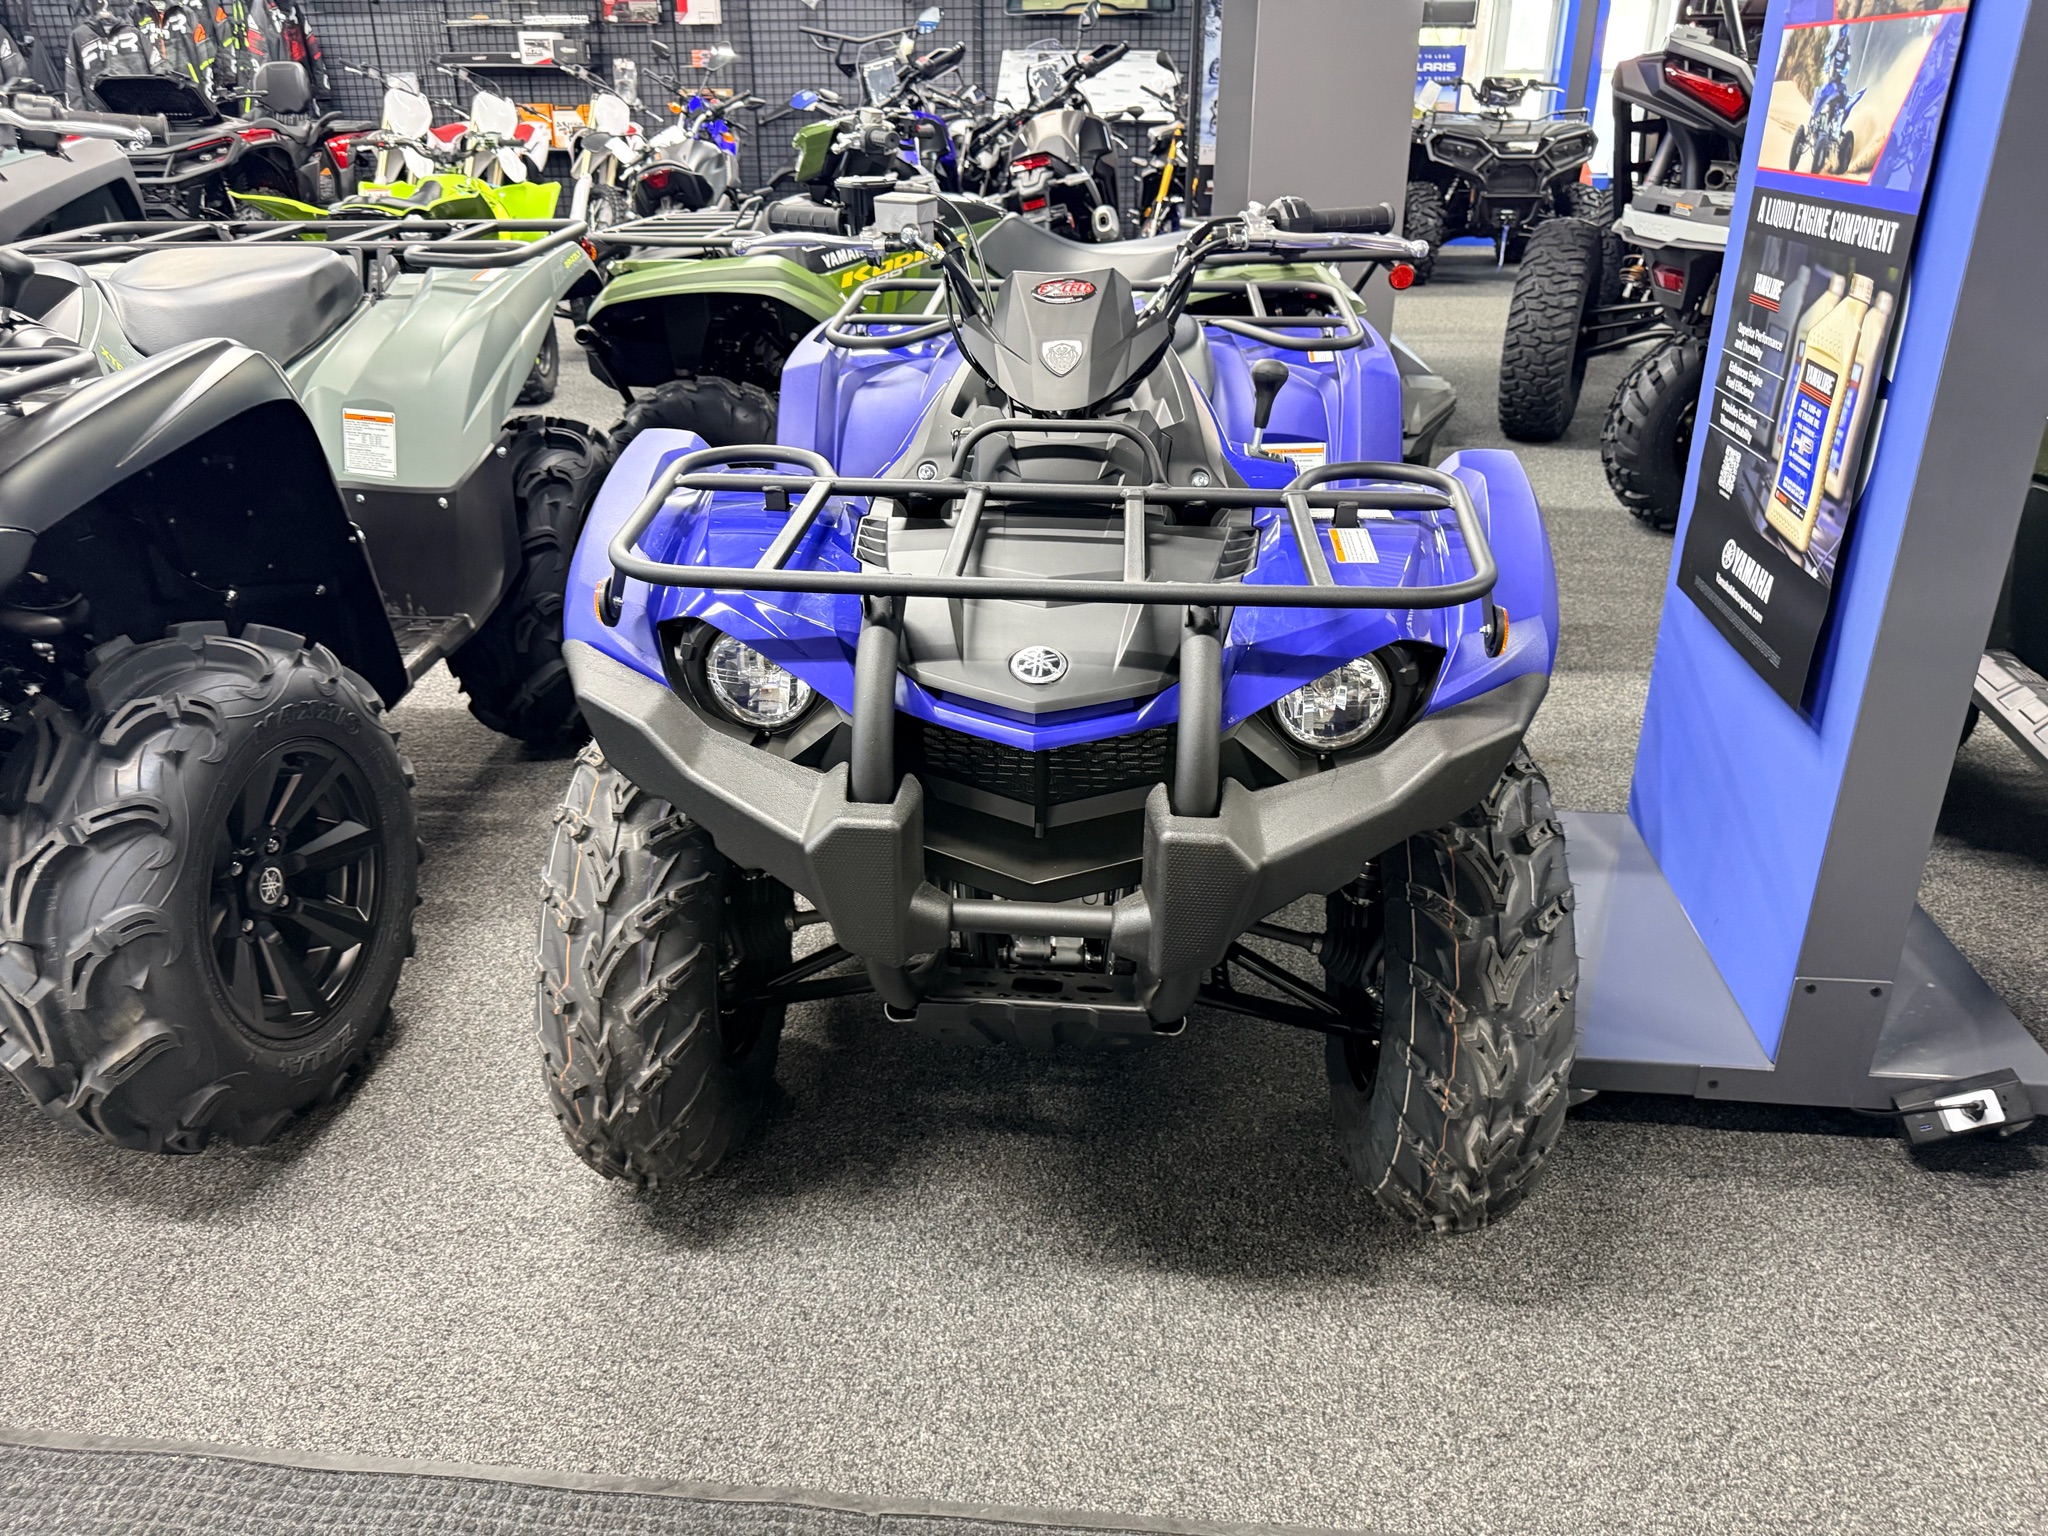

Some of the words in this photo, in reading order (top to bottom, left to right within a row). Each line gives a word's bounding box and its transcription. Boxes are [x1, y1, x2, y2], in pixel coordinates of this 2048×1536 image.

[1416, 62, 1457, 72] LARIS
[1757, 196, 1767, 223] A
[1765, 197, 1796, 230] LIQUID
[1794, 203, 1832, 239] ENGINE
[1829, 210, 1900, 254] COMPONENT
[1754, 272, 1785, 301] YAMALUBE
[1734, 338, 1744, 351] and
[1743, 340, 1763, 362] Durability
[1737, 321, 1756, 339] Superior
[1754, 328, 1783, 352] Performance
[1725, 375, 1736, 390] Fuel
[1734, 380, 1755, 403] Efficiency
[1728, 360, 1749, 380] Enhances
[1747, 370, 1764, 388] Engine
[1805, 363, 1836, 396] YAMALUBE
[1720, 412, 1737, 432] Thermal
[1735, 422, 1753, 445] Stability
[1721, 398, 1739, 419] Provides
[1738, 408, 1758, 430] Excellent
[1791, 428, 1814, 455] HP
[1731, 546, 1775, 605] YAMAHA
